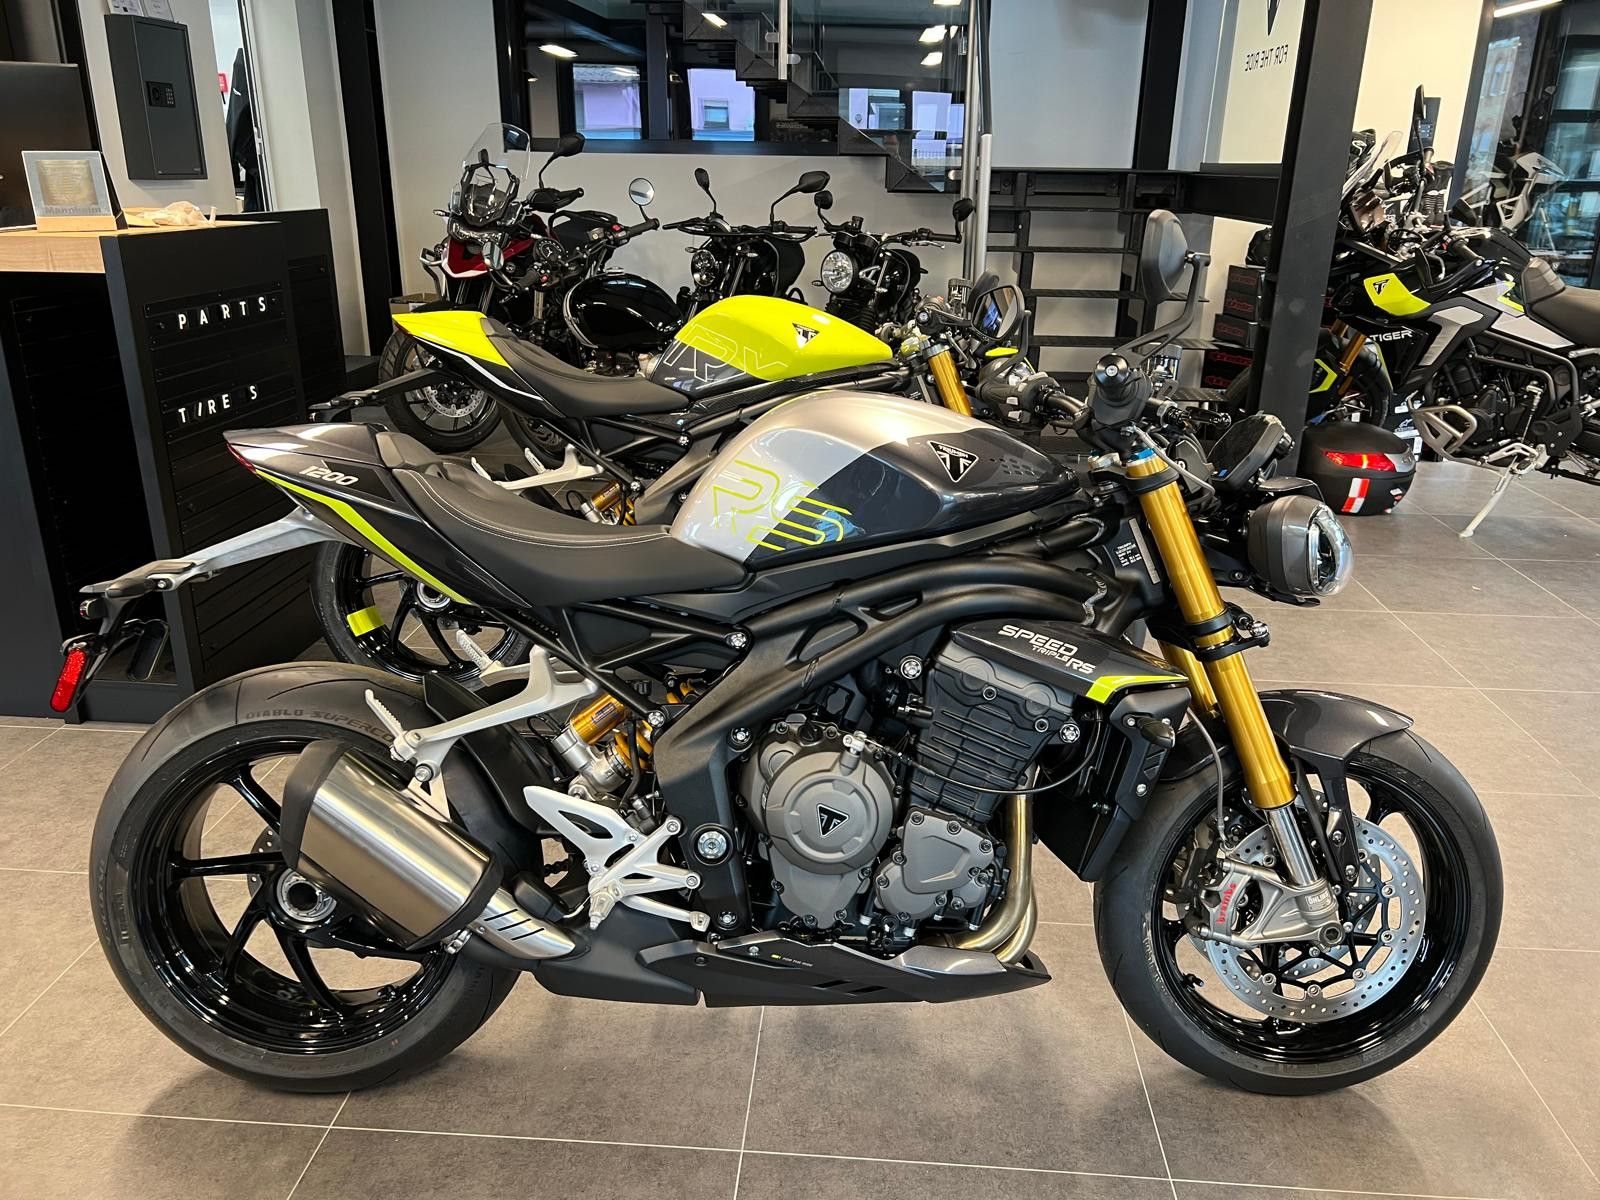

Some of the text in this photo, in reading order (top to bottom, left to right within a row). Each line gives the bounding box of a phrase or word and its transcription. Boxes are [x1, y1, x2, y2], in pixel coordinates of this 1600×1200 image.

[178, 296, 267, 330] PARTS
[1369, 329, 1413, 342] TIGER
[298, 465, 359, 486] 1200
[997, 624, 1078, 656] SPEED
[1065, 657, 1097, 675] RS
[245, 709, 394, 743] DIABLO SUPERCO
